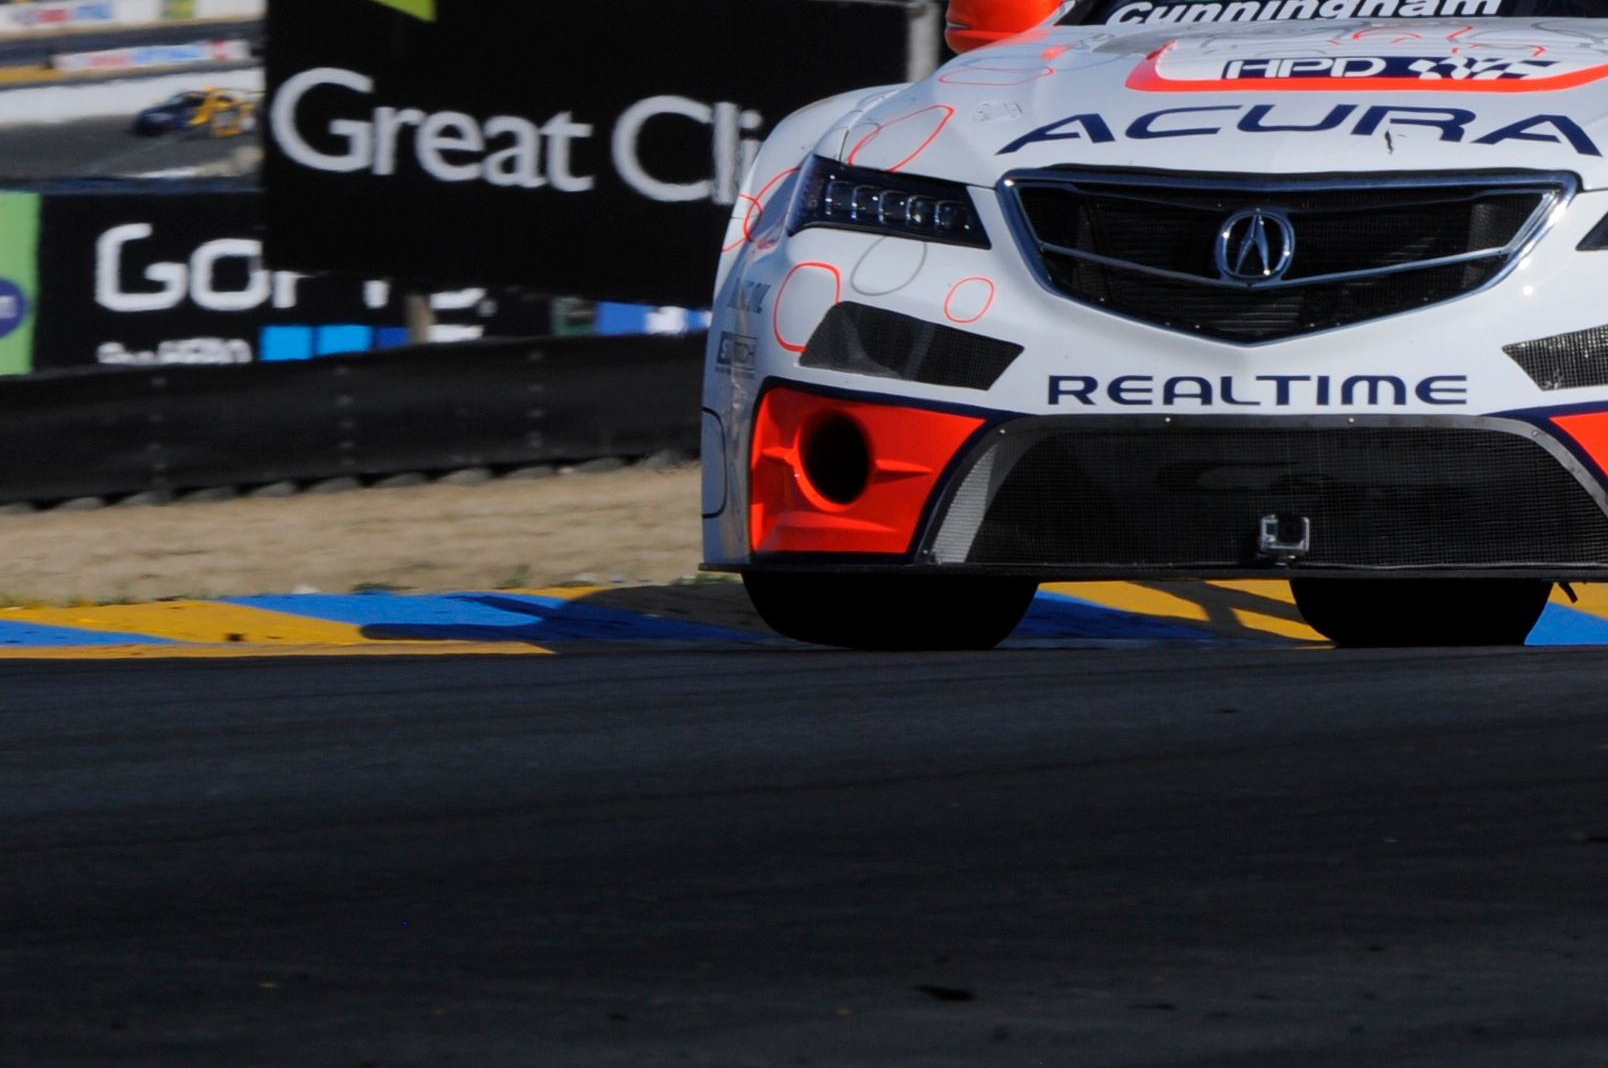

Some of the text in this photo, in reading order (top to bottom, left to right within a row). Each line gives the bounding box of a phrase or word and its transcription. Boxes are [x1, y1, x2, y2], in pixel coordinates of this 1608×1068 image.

[1222, 56, 1387, 80] HPD
[270, 67, 594, 192] Great
[994, 103, 1605, 158] ACURA
[1047, 375, 1468, 406] REALTIME
